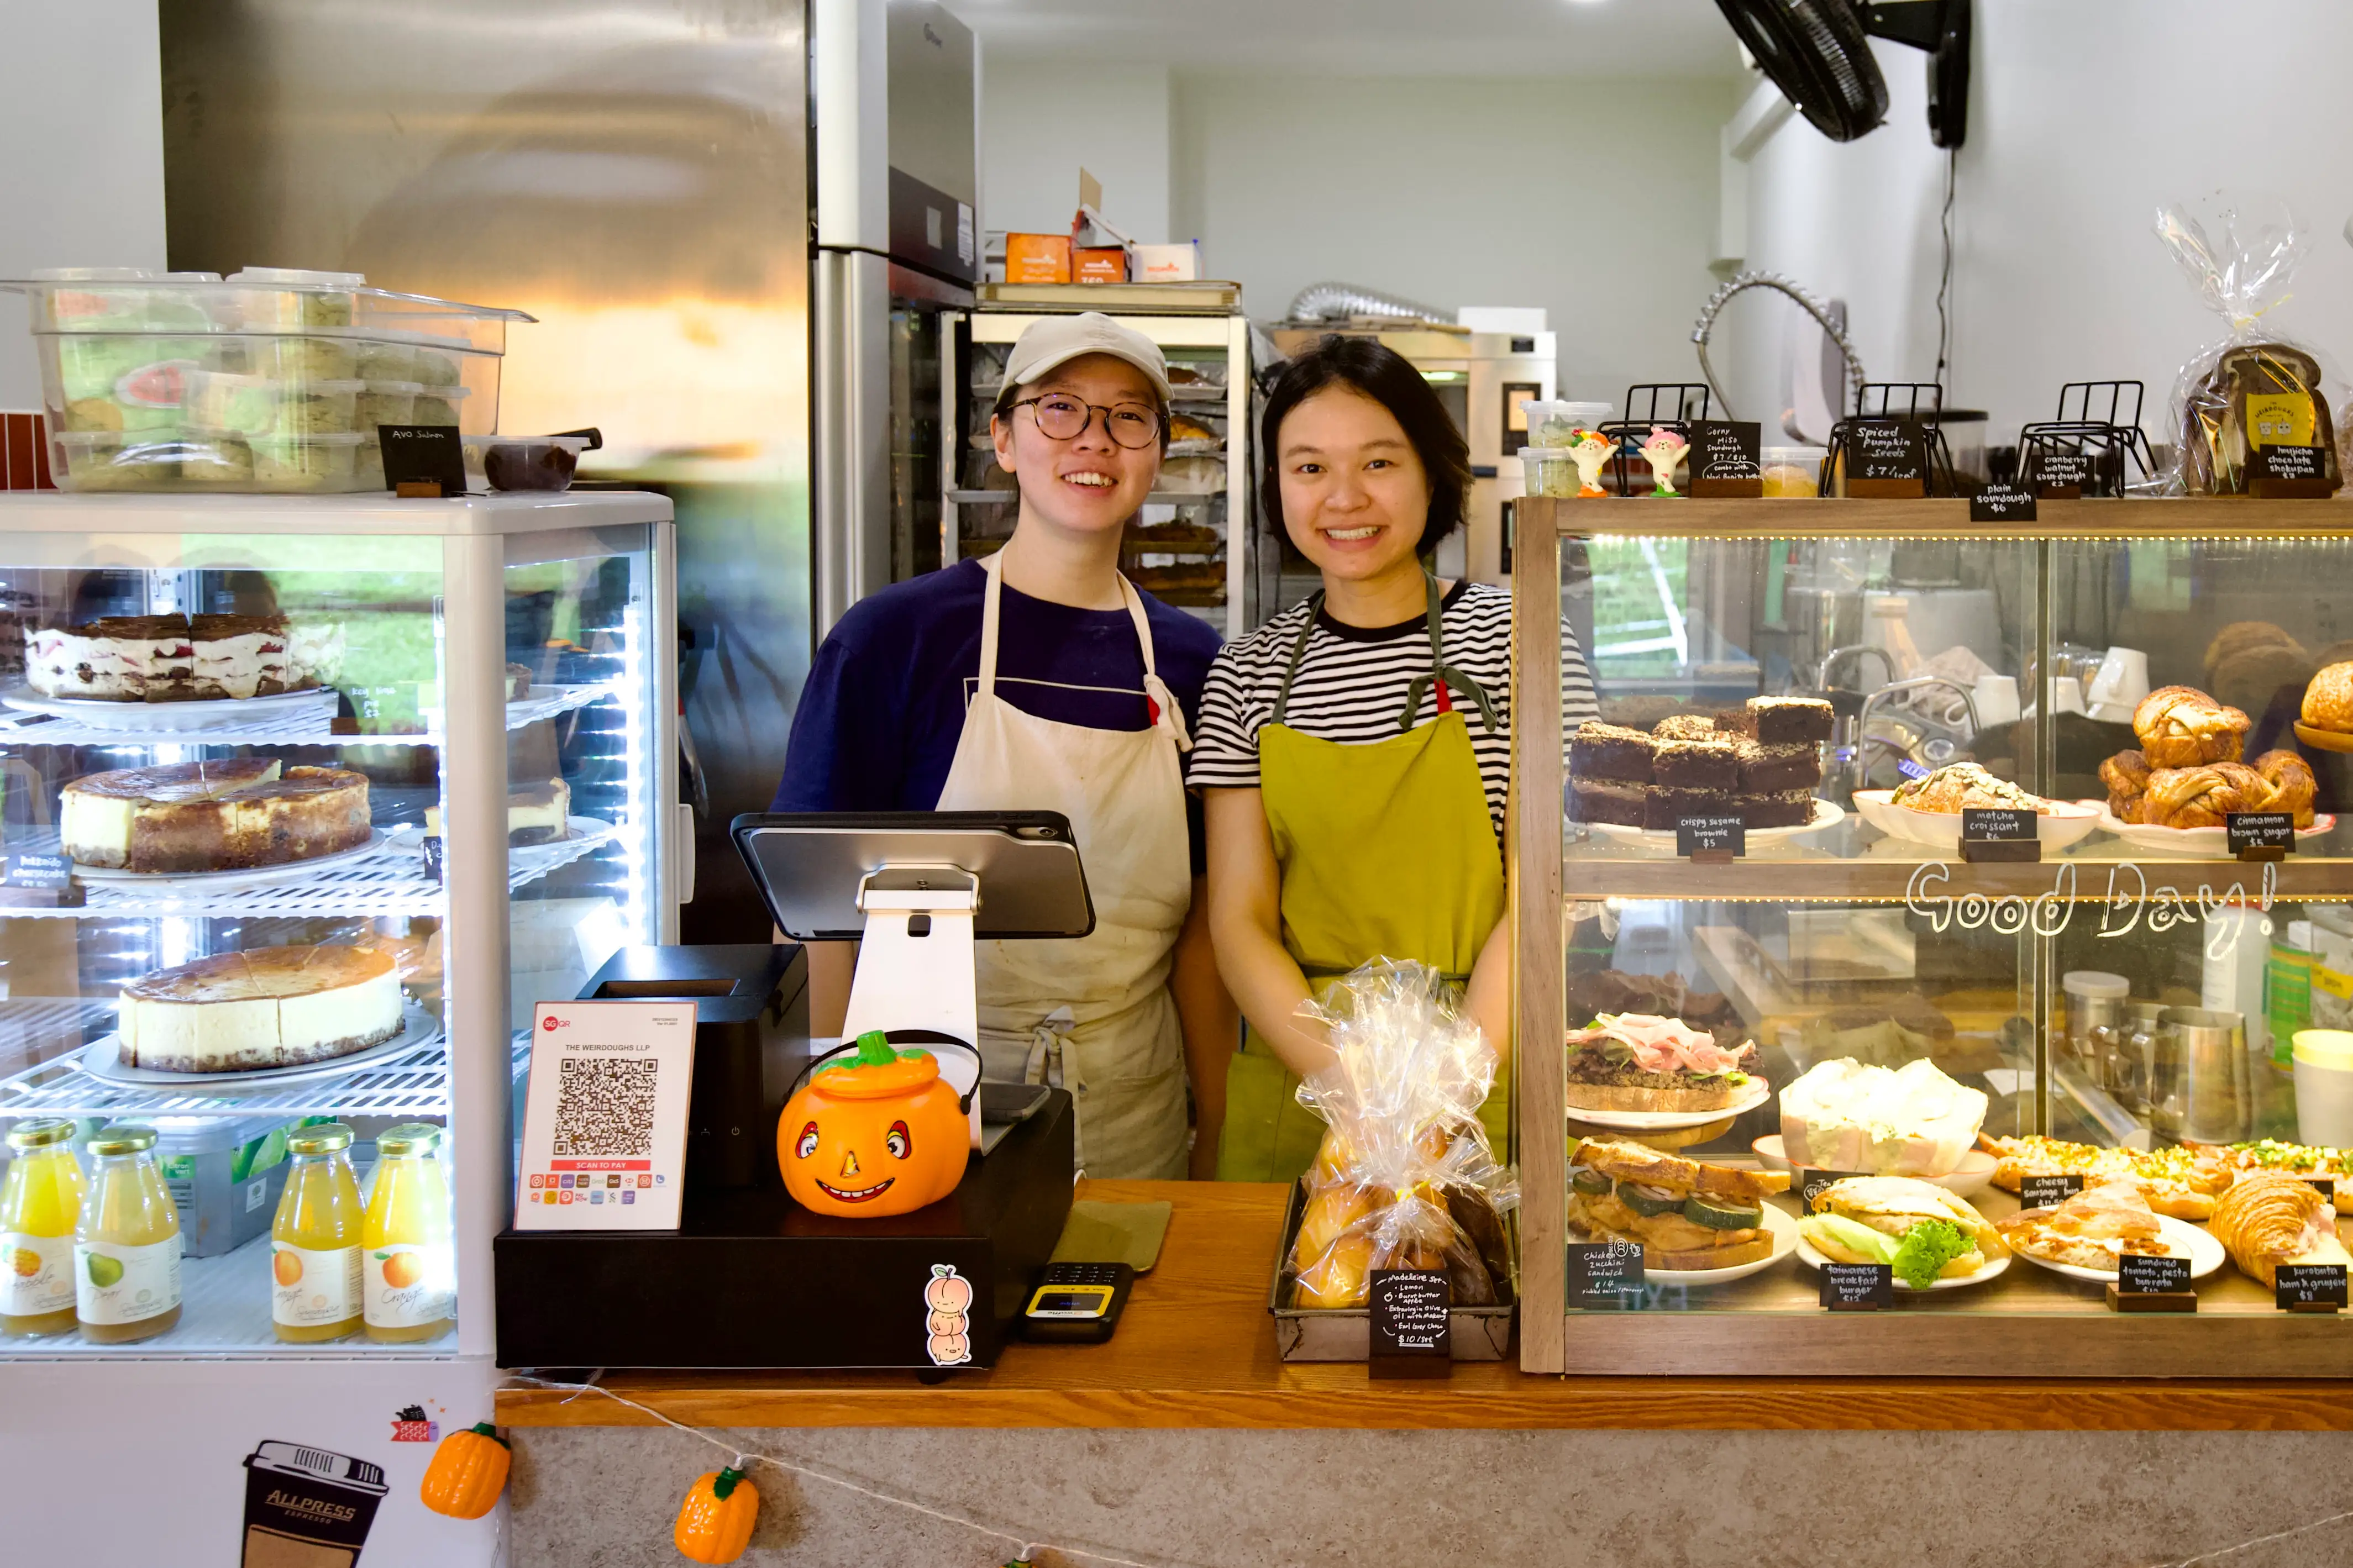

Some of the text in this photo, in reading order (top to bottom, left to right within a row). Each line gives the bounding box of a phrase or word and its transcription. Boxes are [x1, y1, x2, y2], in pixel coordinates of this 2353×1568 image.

[392, 430, 413, 439] AVO
[2045, 456, 2087, 467] cranberry
[2267, 455, 2312, 465] chocolate
[2045, 464, 2076, 473] walnut
[2270, 464, 2314, 474] shokupan
[2036, 471, 2086, 482] sourdough
[1987, 484, 2011, 495] plain
[1977, 492, 2031, 505] sourdough
[1990, 503, 2007, 513] $6
[1976, 811, 2014, 822] matcha
[2237, 815, 2284, 826] cinnamon
[1680, 818, 1706, 828] crispy
[1969, 820, 2020, 832] croissant
[1694, 828, 1728, 837] brownie
[2231, 828, 2291, 840] brown sugar
[1703, 838, 1716, 850] $5
[2250, 836, 2264, 847] $5
[1906, 860, 2276, 961] Good Day!
[2036, 1177, 2068, 1187] cheesy
[2024, 1188, 2058, 1199] sausage
[1589, 1259, 1625, 1269] zucchini
[2137, 1259, 2177, 1267] sundried
[1588, 1268, 1623, 1277] sandwich
[1827, 1264, 1878, 1275] taiwanese
[2162, 1267, 2188, 1280] pesto
[2293, 1265, 2338, 1277] kurobuta
[1388, 1273, 1427, 1283] Madeleine
[1830, 1275, 1878, 1286] breakfast
[2135, 1277, 2172, 1287] burrata
[2279, 1279, 2300, 1289] ham
[1839, 1286, 1872, 1296] burger
[1398, 1322, 1411, 1330] Earl
[266, 1490, 357, 1519] ALLPRESS
[284, 1509, 332, 1524] ESPRESSO
